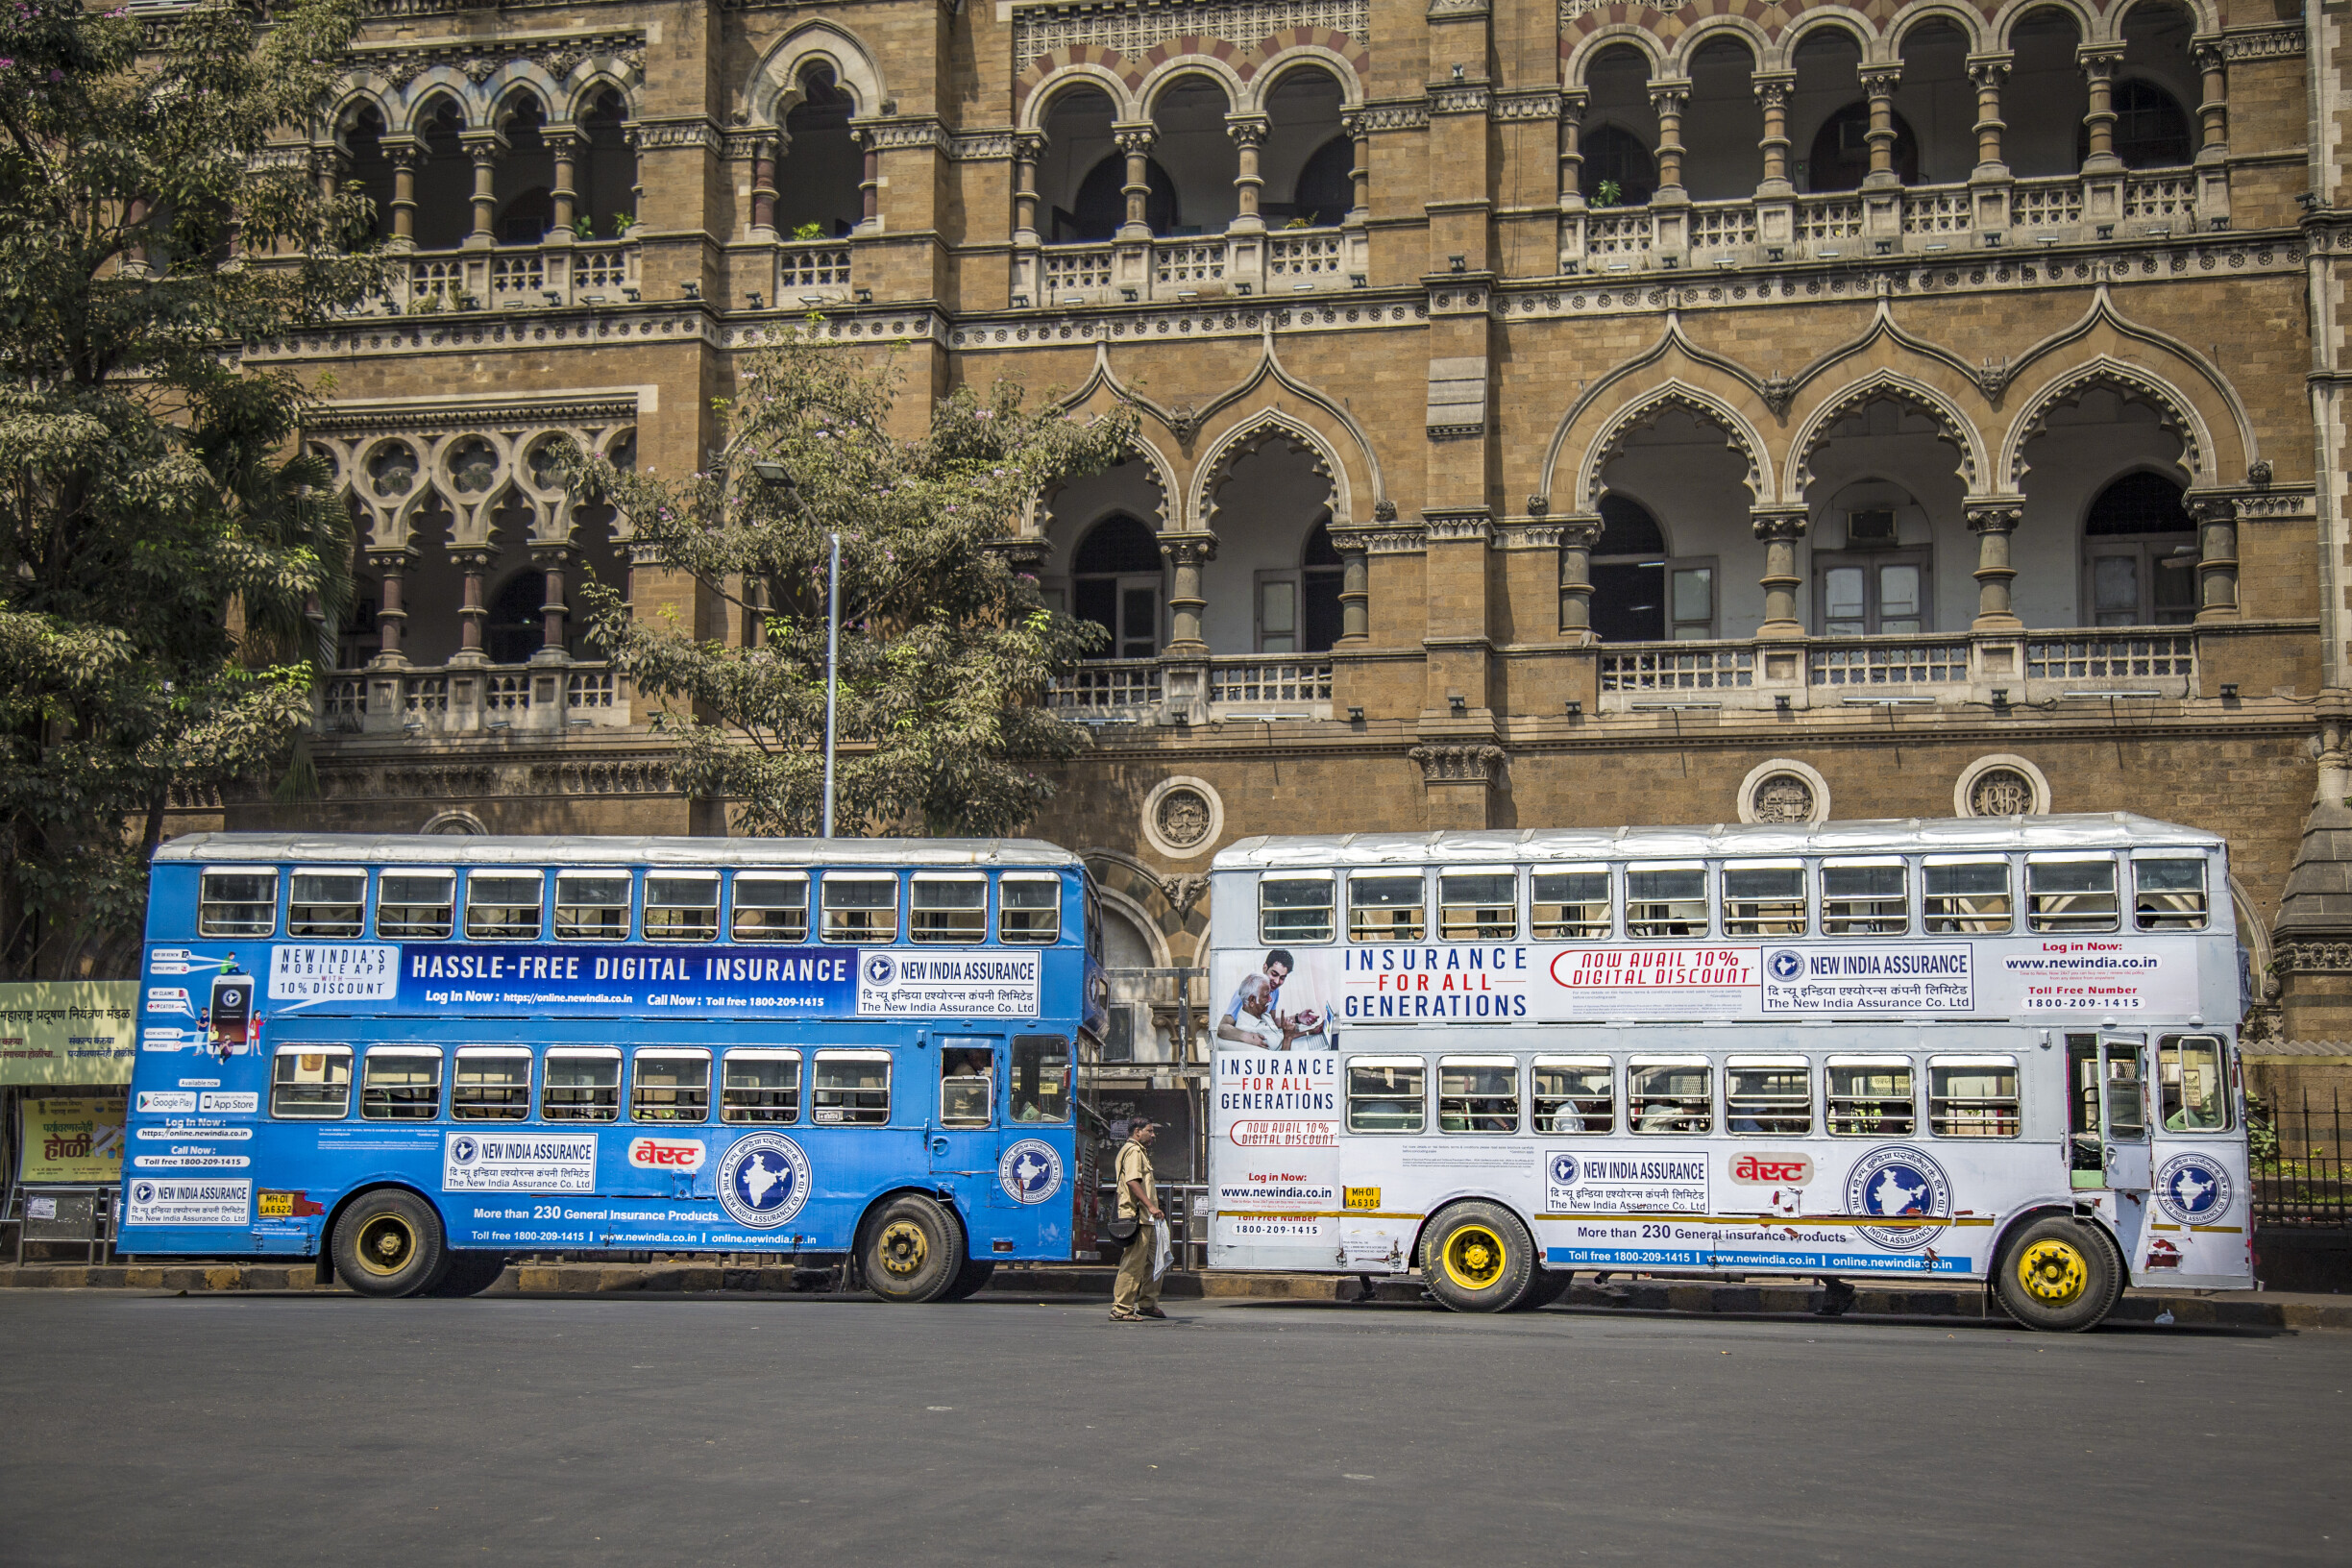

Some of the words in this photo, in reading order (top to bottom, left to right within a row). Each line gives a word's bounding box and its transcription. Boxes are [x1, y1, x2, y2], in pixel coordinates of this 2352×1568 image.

[2043, 943, 2067, 953] Log
[2070, 943, 2084, 951] in
[2087, 942, 2122, 951] Now:
[282, 948, 315, 964] NEW
[322, 948, 385, 964] INDIA'S
[1345, 947, 1527, 970] INSURANCE
[1695, 951, 1739, 967] 10%
[2006, 956, 2158, 968] www.newindia.co.in
[281, 964, 345, 974] MOBILE
[355, 964, 385, 974] APP
[412, 955, 579, 979] HASSLE-FREE
[595, 957, 691, 980] DIGITAL
[705, 958, 846, 982] INSURANCE
[900, 961, 927, 980] NEW
[930, 962, 960, 980] INDIA
[964, 962, 1035, 981] ASSURANCE
[1810, 956, 1841, 975] NEW
[1844, 955, 1880, 974] INDIA
[1883, 954, 1968, 974] ASSURANCE
[1379, 973, 1430, 992] FOR
[1442, 973, 1491, 991] ALL
[1573, 969, 1647, 985] DIGITAL
[281, 982, 307, 993] 10%
[1768, 985, 1779, 996] दि
[1783, 987, 1799, 999] न्यू
[1801, 985, 1836, 996] इन्डिया
[1891, 984, 1922, 995] कंपनी
[1925, 983, 1969, 995] लिमिटेड
[2028, 986, 2052, 994] Toll
[2056, 986, 2084, 994] Free
[2088, 986, 2138, 994] Number
[426, 990, 448, 1005] Log
[451, 991, 463, 1002] In
[503, 992, 632, 1005] https://online.newindia.co.in
[647, 994, 668, 1006] Call
[706, 997, 724, 1006] Toll
[726, 997, 747, 1007] free
[749, 997, 824, 1007] 1800-209-1415
[863, 988, 872, 1000] दि
[875, 992, 890, 1003] न्यू
[892, 989, 921, 1001] इन्डिया
[968, 989, 994, 1000] कंपनी
[997, 989, 1034, 1001] लिमिटेड
[1768, 998, 1790, 1008] The
[1793, 998, 1820, 1008] New
[1823, 997, 1853, 1008] India
[1857, 998, 1922, 1008] Assurance
[1925, 998, 1946, 1008] Co.
[1949, 997, 1969, 1008] Ltd
[2027, 998, 2139, 1008] 1800-209-1415
[862, 1002, 881, 1012] The
[884, 1002, 908, 1012] New
[910, 1002, 936, 1012] India
[940, 1002, 994, 1013] Assurance
[997, 1003, 1015, 1013] Co.
[1017, 1003, 1035, 1013] Ltd
[1345, 994, 1527, 1017] GENERATIONS
[36, 1009, 66, 1025] प्रदूषण
[68, 1006, 104, 1020] नियंत्रण
[107, 1005, 131, 1019] मंडळ
[1221, 1059, 1335, 1075] INSURANCE
[1242, 1077, 1274, 1090] FOR
[1281, 1077, 1312, 1090] ALL
[153, 1097, 178, 1110] Google
[180, 1098, 193, 1110] Play
[213, 1100, 231, 1111] App
[233, 1099, 255, 1110] Store
[1221, 1092, 1334, 1110] GENERATIONS
[165, 1117, 184, 1128] Log
[185, 1117, 196, 1126] In
[1306, 1122, 1330, 1134] 10%
[141, 1130, 248, 1139] https://online.newindia.co.in
[1241, 1135, 1281, 1145] DIGITAL
[43, 1133, 93, 1162] होळी
[171, 1145, 188, 1155] Call
[482, 1142, 503, 1160] NEW
[505, 1143, 530, 1160] INDIA
[532, 1143, 592, 1161] ASSURANCE
[635, 1140, 699, 1165] बेस्ट
[1736, 1156, 1806, 1182] बेस्ट
[1248, 1173, 1267, 1183] Log
[1268, 1173, 1279, 1182] in
[1281, 1173, 1307, 1182] Now:
[1221, 1187, 1332, 1198] www.newindia.co.in
[474, 1208, 502, 1218] More
[504, 1209, 528, 1218] than
[533, 1206, 561, 1219] 230
[564, 1209, 607, 1220] General
[610, 1209, 665, 1220] Insurance
[669, 1211, 719, 1221] Products
[725, 1192, 738, 1209] NEW
[735, 1207, 752, 1221] INDIA
[753, 1206, 794, 1223] ASSURANCE
[472, 1231, 490, 1240] Toll
[491, 1231, 511, 1240] free
[514, 1232, 584, 1241] 1800-209-1415
[1237, 1225, 1317, 1235] 1800-209-1415
[1578, 1226, 1607, 1237] More
[1610, 1227, 1637, 1237] than
[1642, 1224, 1671, 1238] 230
[1675, 1228, 1722, 1240] General
[1569, 1250, 1587, 1261] Toll
[1590, 1251, 1611, 1261] free
[1614, 1251, 1691, 1262] 1800-209-1415
